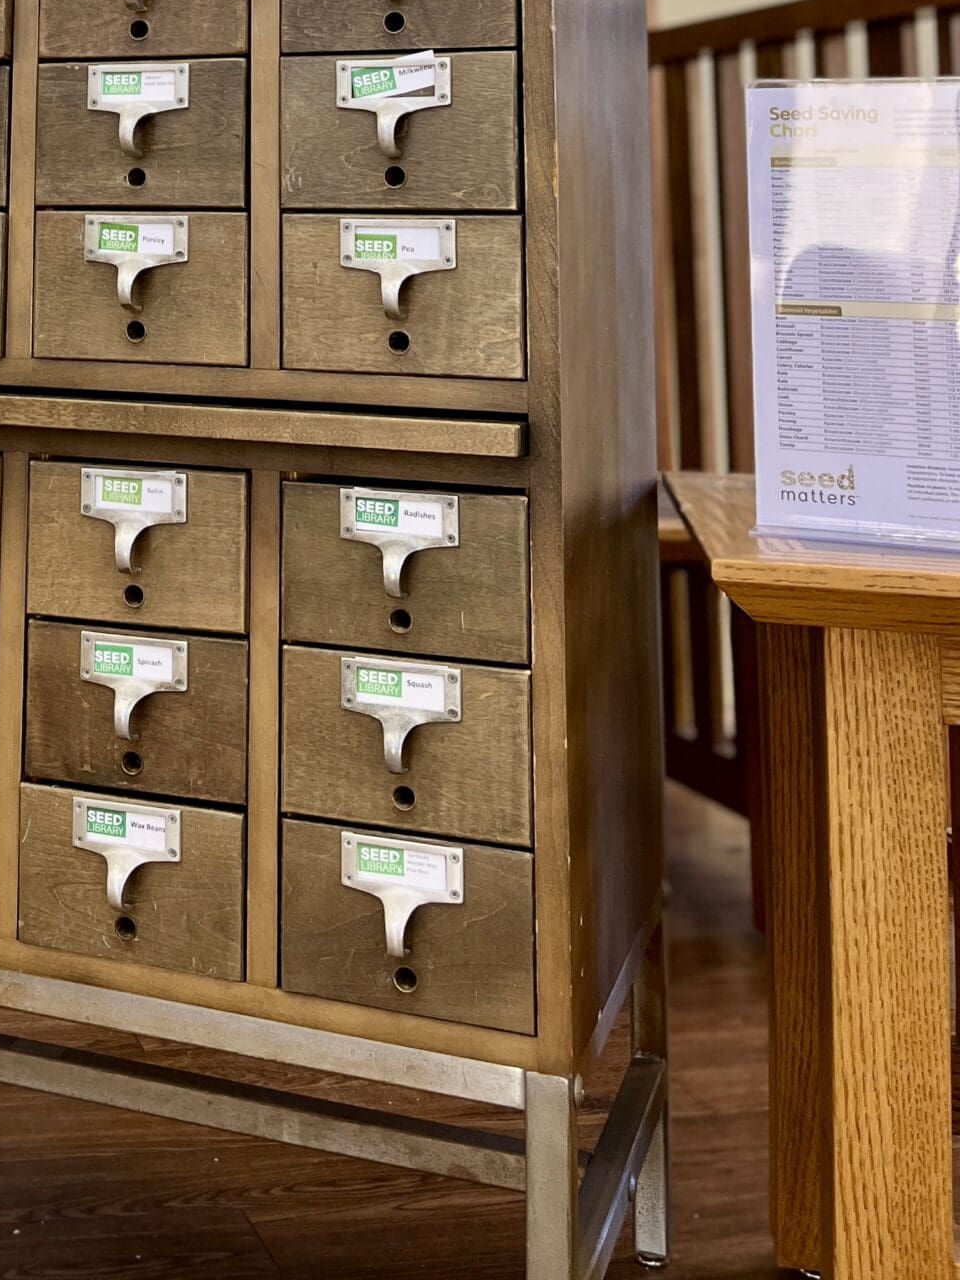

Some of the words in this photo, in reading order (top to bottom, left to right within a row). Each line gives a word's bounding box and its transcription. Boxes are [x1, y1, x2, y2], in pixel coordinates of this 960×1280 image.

[105, 75, 136, 85] SEED
[353, 70, 390, 87] SEED
[104, 85, 139, 94] LIBRARY
[355, 81, 393, 96] LIBRARY
[769, 106, 812, 121] Seed
[818, 105, 878, 123] Saving
[101, 229, 134, 240] SEED
[142, 235, 165, 244] Parsley
[101, 240, 136, 250] LIBRARY
[356, 240, 393, 251] SEED
[781, 464, 855, 490] seed
[105, 480, 137, 494] SEED
[104, 492, 141, 503] LIBRARY
[781, 489, 856, 505] matters
[357, 500, 395, 514] SEED
[356, 512, 397, 525] LIBRARY
[404, 510, 436, 520] Radishes
[95, 650, 129, 663] SEED
[137, 658, 162, 667] Spinach
[94, 662, 131, 673] LIBRARY
[360, 669, 398, 684] SEED
[359, 682, 399, 695] LIBRARY
[407, 680, 433, 689] Squash
[88, 811, 121, 826] SEED
[87, 824, 123, 836] LIBRARY
[131, 821, 145, 829] Wax
[147, 824, 166, 833] Beans
[361, 847, 400, 862] SEED
[361, 861, 403, 873] LIBRARY
